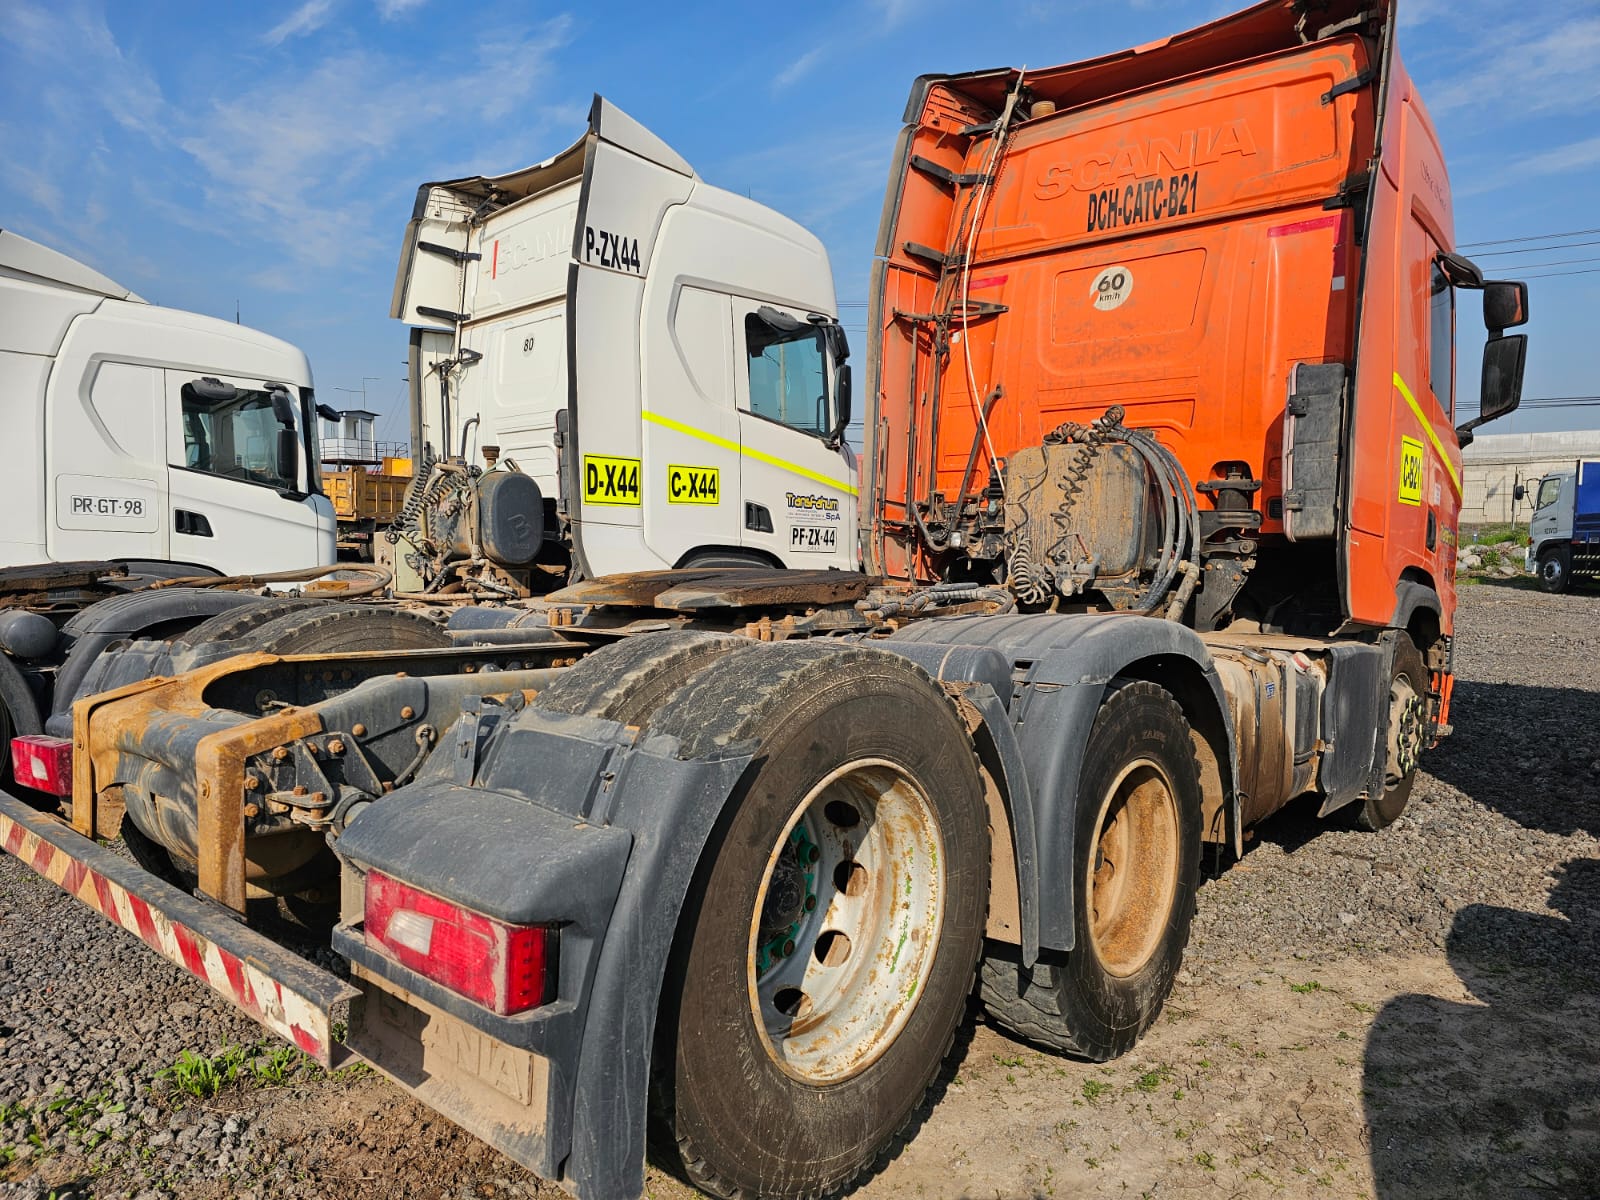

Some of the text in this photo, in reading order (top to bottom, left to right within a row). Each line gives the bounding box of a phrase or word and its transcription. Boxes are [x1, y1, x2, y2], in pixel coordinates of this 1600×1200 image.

[1033, 117, 1257, 201] SCANIA
[1087, 171, 1199, 232] DCH-CATC-B21
[585, 226, 641, 273] P-ZX44
[1097, 273, 1125, 292] 60
[1099, 292, 1120, 302] km/h
[523, 337, 534, 352] 80
[587, 463, 639, 498] D-X44
[671, 471, 717, 499] C-X44
